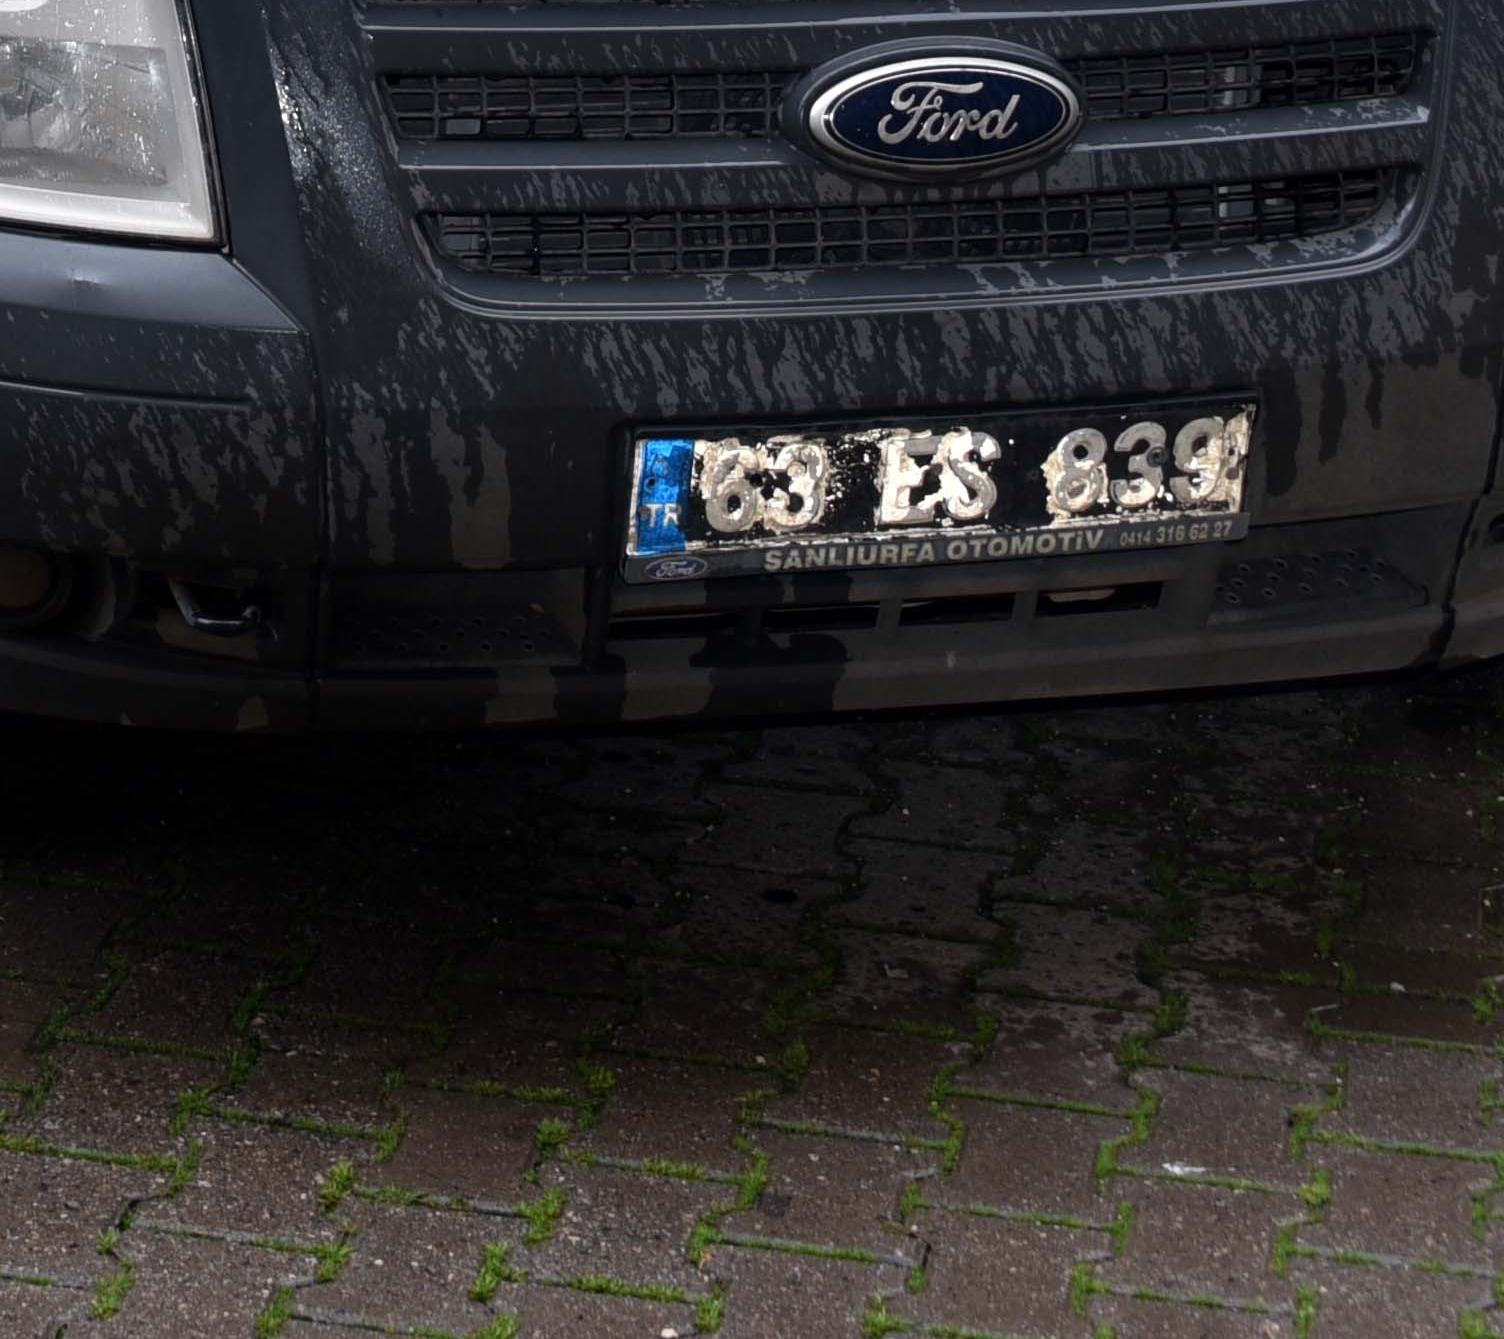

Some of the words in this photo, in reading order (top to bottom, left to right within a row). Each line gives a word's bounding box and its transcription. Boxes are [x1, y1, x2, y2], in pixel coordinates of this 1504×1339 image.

[877, 81, 1020, 145] Ford
[705, 443, 826, 533] 63
[880, 429, 1002, 524] ES
[1054, 417, 1224, 514] 839
[643, 503, 682, 528] TR
[655, 560, 698, 579] Ford
[763, 542, 936, 572] SANLIURFA
[1119, 530, 1152, 547] 0414
[1156, 525, 1185, 544] 316
[1189, 523, 1209, 540] 62
[1213, 521, 1232, 538] 27
